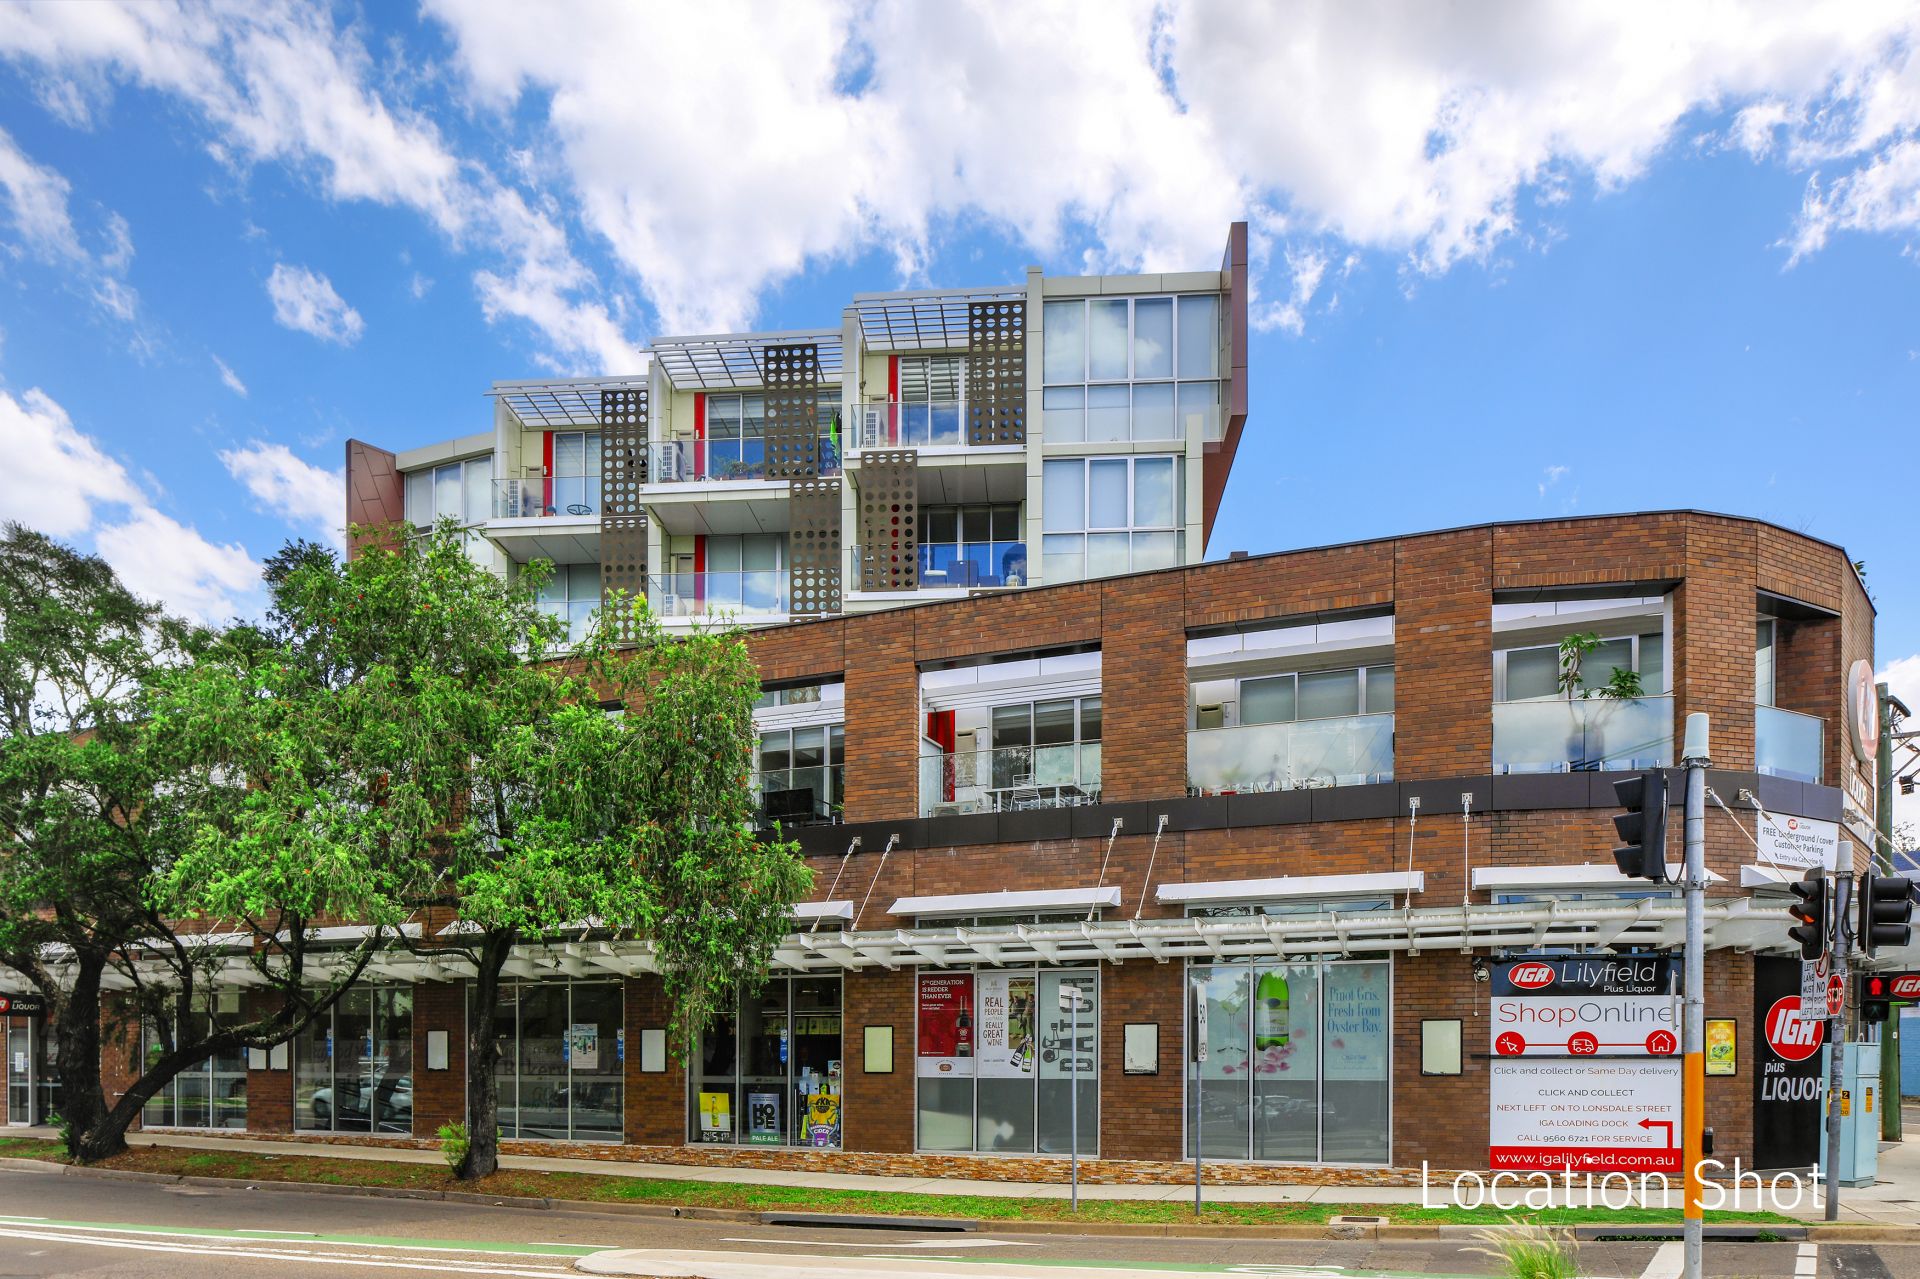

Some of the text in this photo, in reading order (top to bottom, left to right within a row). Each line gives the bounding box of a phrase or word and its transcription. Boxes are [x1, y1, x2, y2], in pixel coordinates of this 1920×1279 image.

[1763, 826, 1776, 837] FREE
[1803, 843, 1824, 857] Parking
[1804, 962, 1815, 972] LEFT
[1514, 961, 1657, 988] IGA Lilyfield
[1803, 974, 1814, 983] LANE
[1603, 985, 1657, 994] Plus Liquor
[1802, 985, 1814, 994] MUST
[1816, 981, 1826, 993] NO
[1329, 986, 1354, 1001] Pinot
[1827, 987, 1843, 1003] STOP
[985, 997, 1004, 1008] REAL
[984, 1008, 1003, 1016] PEOPLE
[1328, 1002, 1381, 1017] Fresh from
[1802, 1008, 1813, 1016] LEFT
[1814, 1008, 1826, 1016] TURN
[1499, 1002, 1672, 1028] ShopOnline
[1327, 1019, 1360, 1038] Oyster
[1771, 1008, 1816, 1046] IGA
[983, 1029, 1004, 1039] GREAT
[987, 1039, 1003, 1047] WINE
[1494, 1067, 1517, 1075] Click
[1519, 1067, 1538, 1075] and
[1540, 1067, 1573, 1075] collect
[1587, 1067, 1616, 1075] Same
[1618, 1067, 1637, 1077] Day
[1639, 1067, 1679, 1077] delivery
[1538, 1089, 1635, 1097] CLICK AND COLLECT
[1496, 1104, 1521, 1112] NEXT
[1523, 1104, 1546, 1112] LEFT
[1582, 1105, 1633, 1113] LONSDALE
[1635, 1105, 1672, 1113] STREET
[1539, 1119, 1629, 1128] IGA LOADING DOCK
[1517, 1134, 1541, 1142] CALL
[1543, 1134, 1566, 1143] 9560
[1568, 1135, 1589, 1143] 6721
[1612, 1135, 1653, 1143] SERVICE
[1496, 1152, 1675, 1168] www.igalilyfeld.com.au
